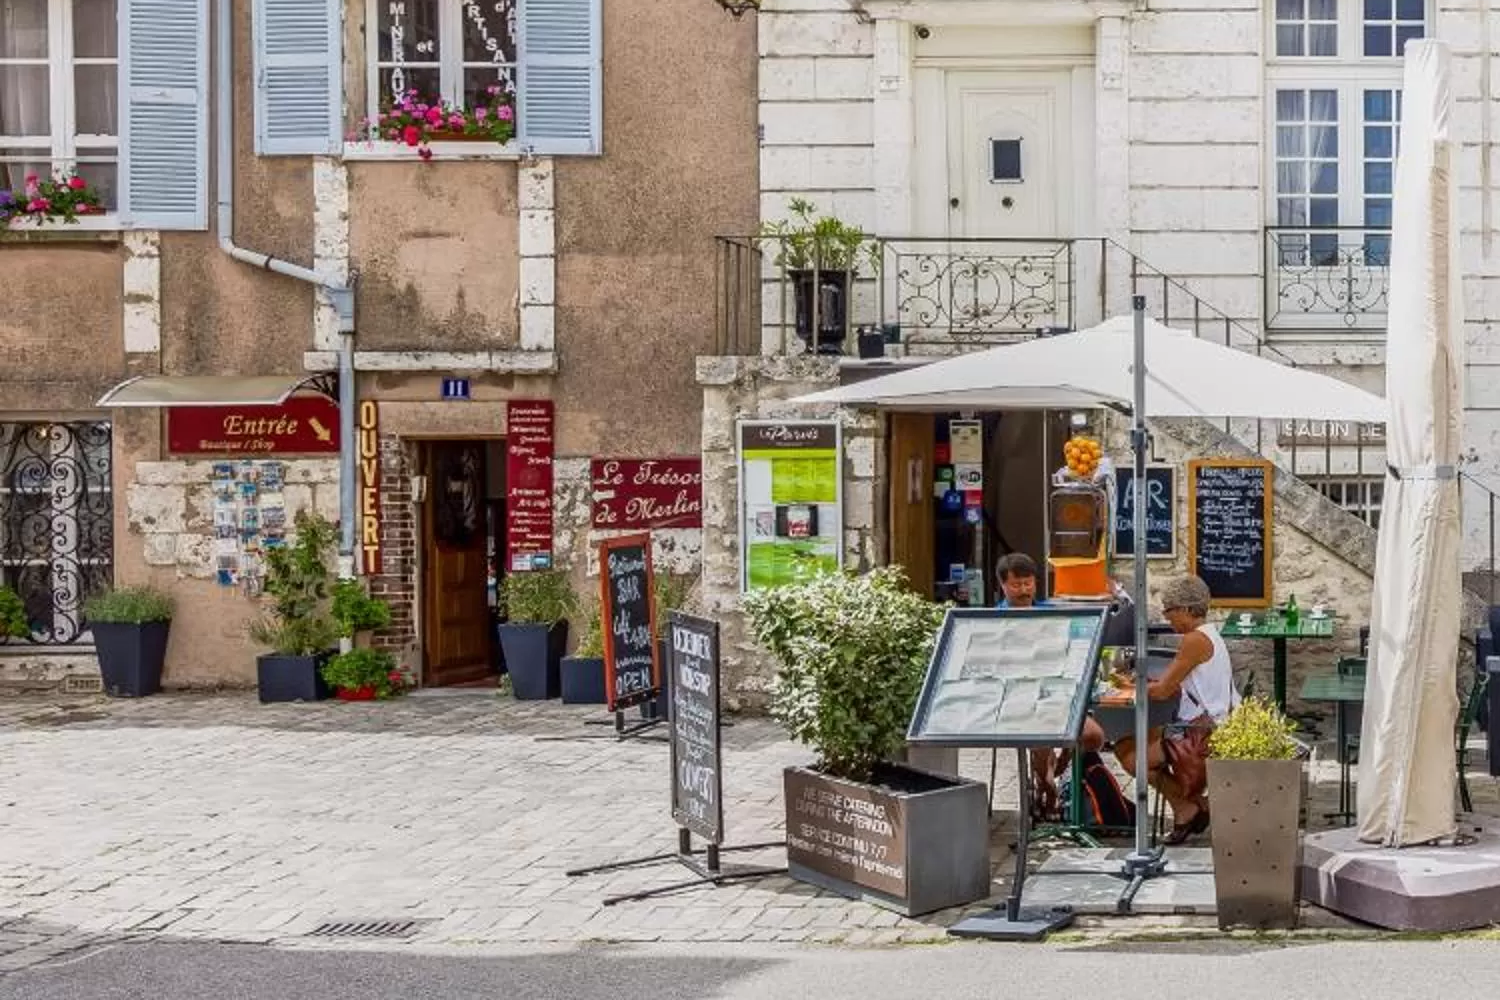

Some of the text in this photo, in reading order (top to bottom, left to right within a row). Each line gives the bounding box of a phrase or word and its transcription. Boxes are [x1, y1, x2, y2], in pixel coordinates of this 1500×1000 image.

[416, 40, 434, 53] et
[449, 381, 463, 395] 11
[223, 413, 299, 436] Entrée
[250, 437, 276, 452] Shop
[593, 461, 701, 485] Le Trésor
[360, 401, 380, 572] OUVERT
[595, 489, 701, 523] de Merlin
[616, 667, 650, 695] OPEN
